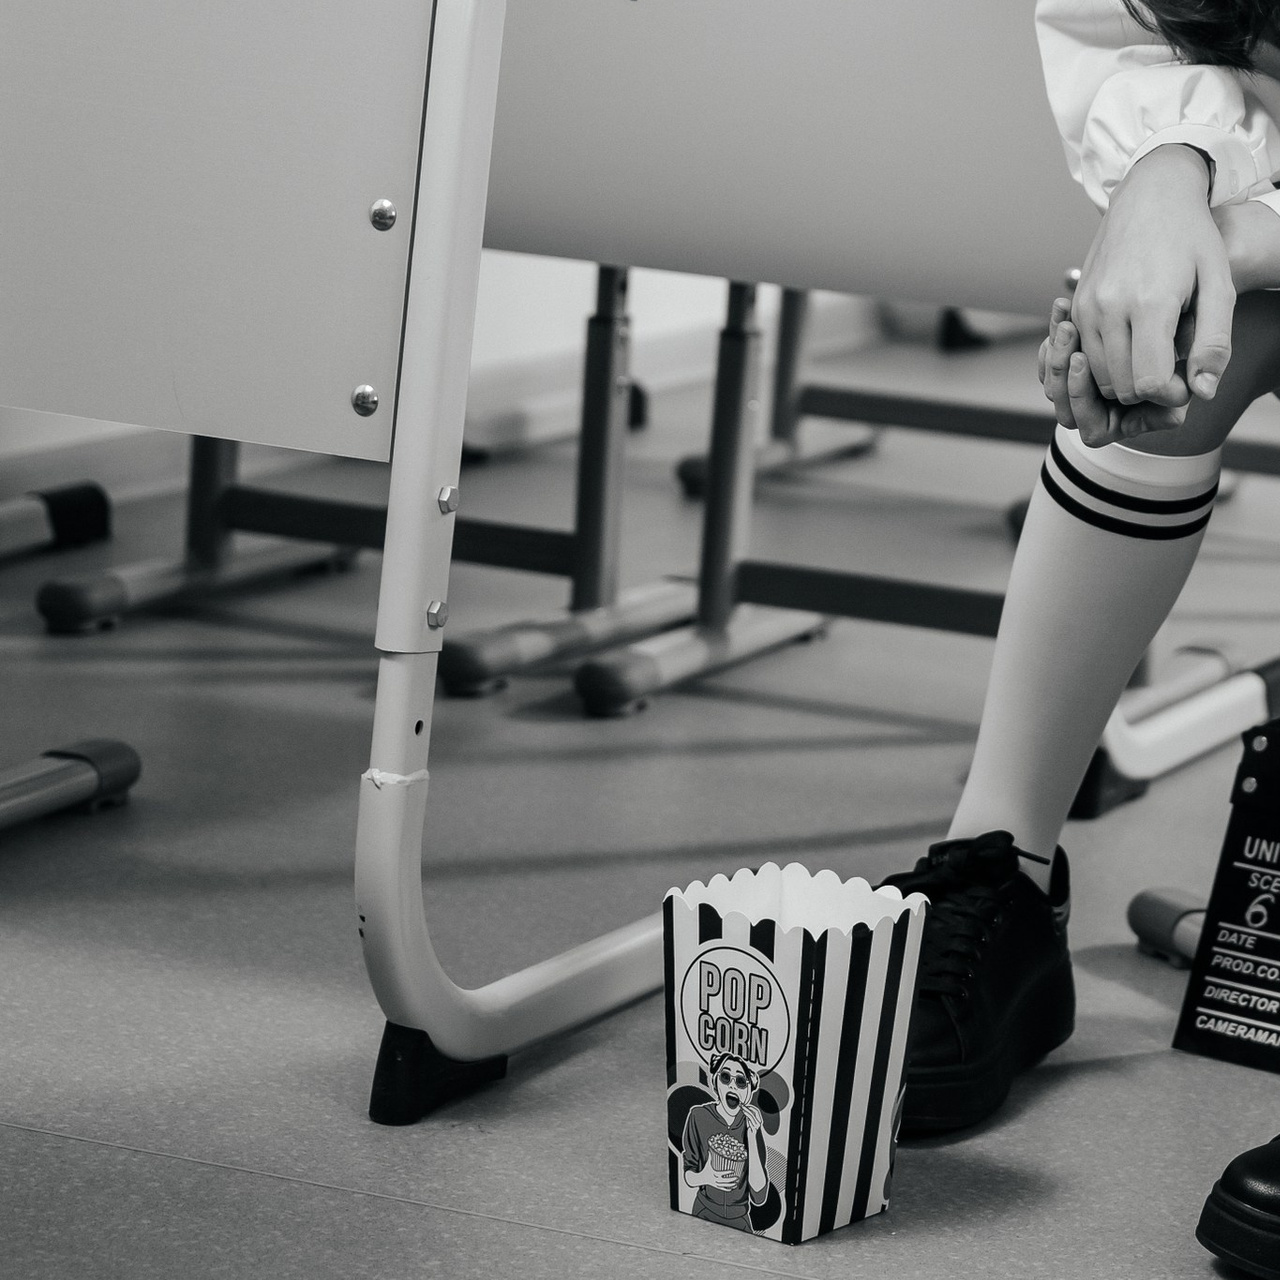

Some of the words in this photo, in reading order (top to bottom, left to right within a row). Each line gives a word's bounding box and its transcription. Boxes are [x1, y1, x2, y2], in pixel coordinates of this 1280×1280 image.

[1244, 893, 1276, 929] 6
[1216, 929, 1257, 950] DATE
[700, 960, 772, 1026] POP
[1204, 985, 1280, 1013] DIRECTOR
[699, 1010, 769, 1066] CORN
